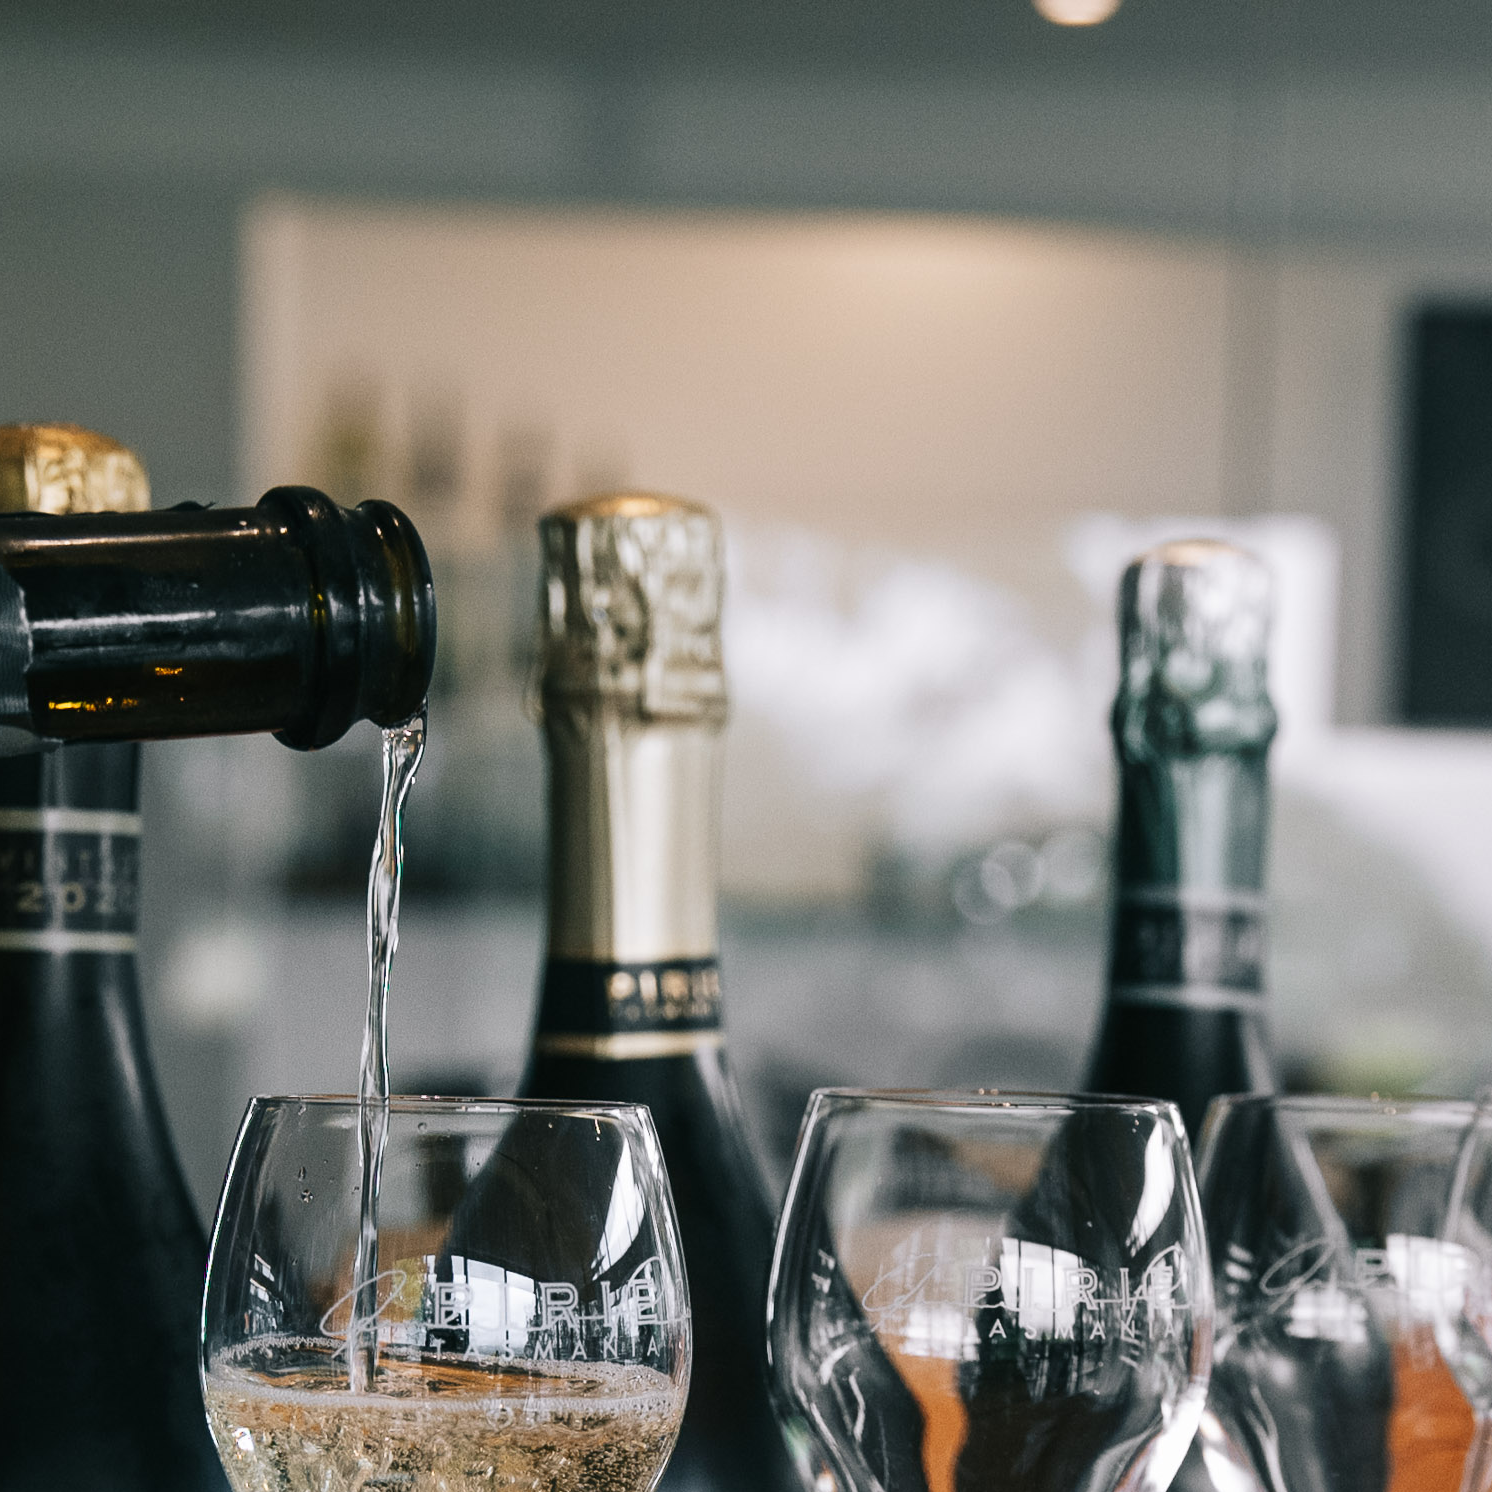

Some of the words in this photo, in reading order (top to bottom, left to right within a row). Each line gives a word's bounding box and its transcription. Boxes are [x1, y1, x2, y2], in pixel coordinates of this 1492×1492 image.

[434, 1279, 658, 1330] PIRIE
[966, 1266, 1175, 1311] PIRIE
[963, 1317, 1176, 1341] ASMANIA
[432, 1335, 661, 1362] TASMANIA
